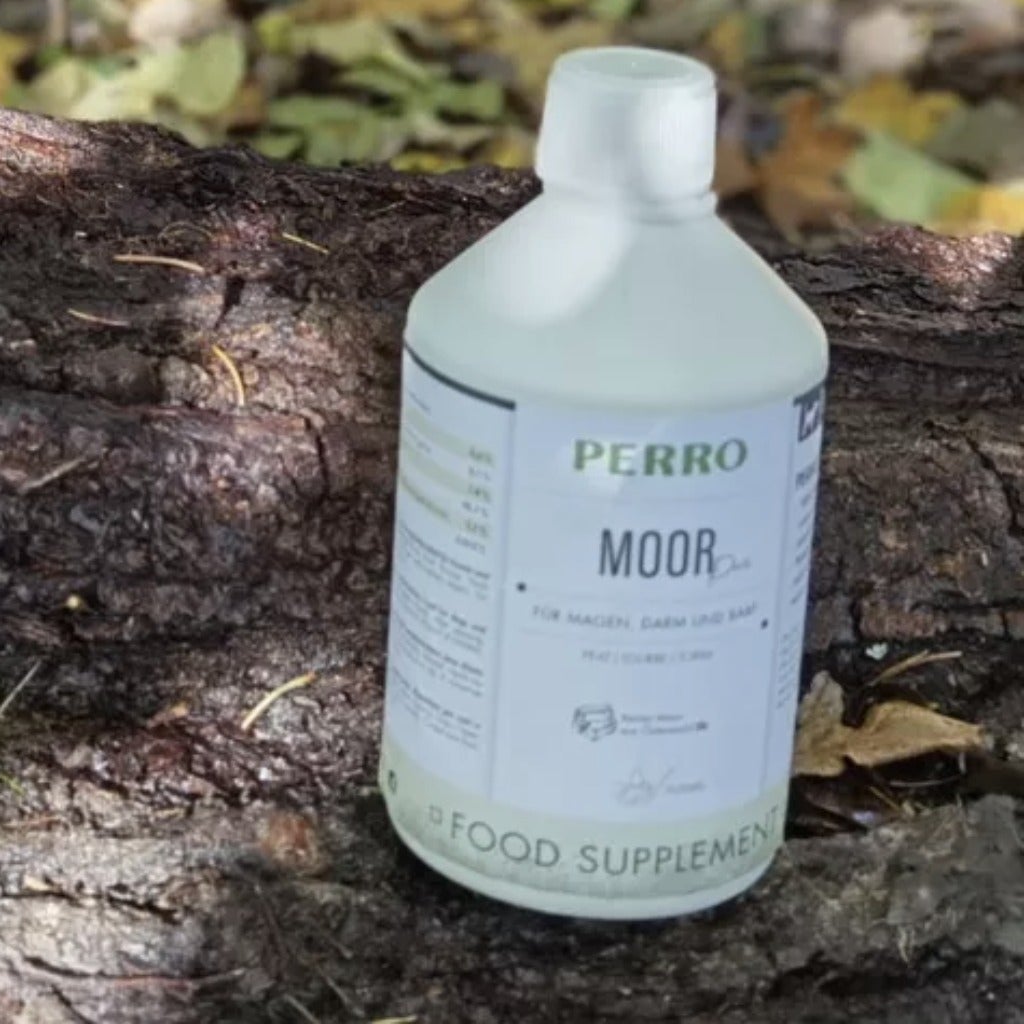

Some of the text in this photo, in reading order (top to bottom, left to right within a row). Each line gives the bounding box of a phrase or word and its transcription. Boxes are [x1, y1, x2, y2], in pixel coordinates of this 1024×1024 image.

[573, 438, 747, 476] PERRO
[598, 527, 717, 578] MOOR
[640, 615, 687, 630] DARM
[450, 803, 780, 876] FOOD SUPPLEMENT
